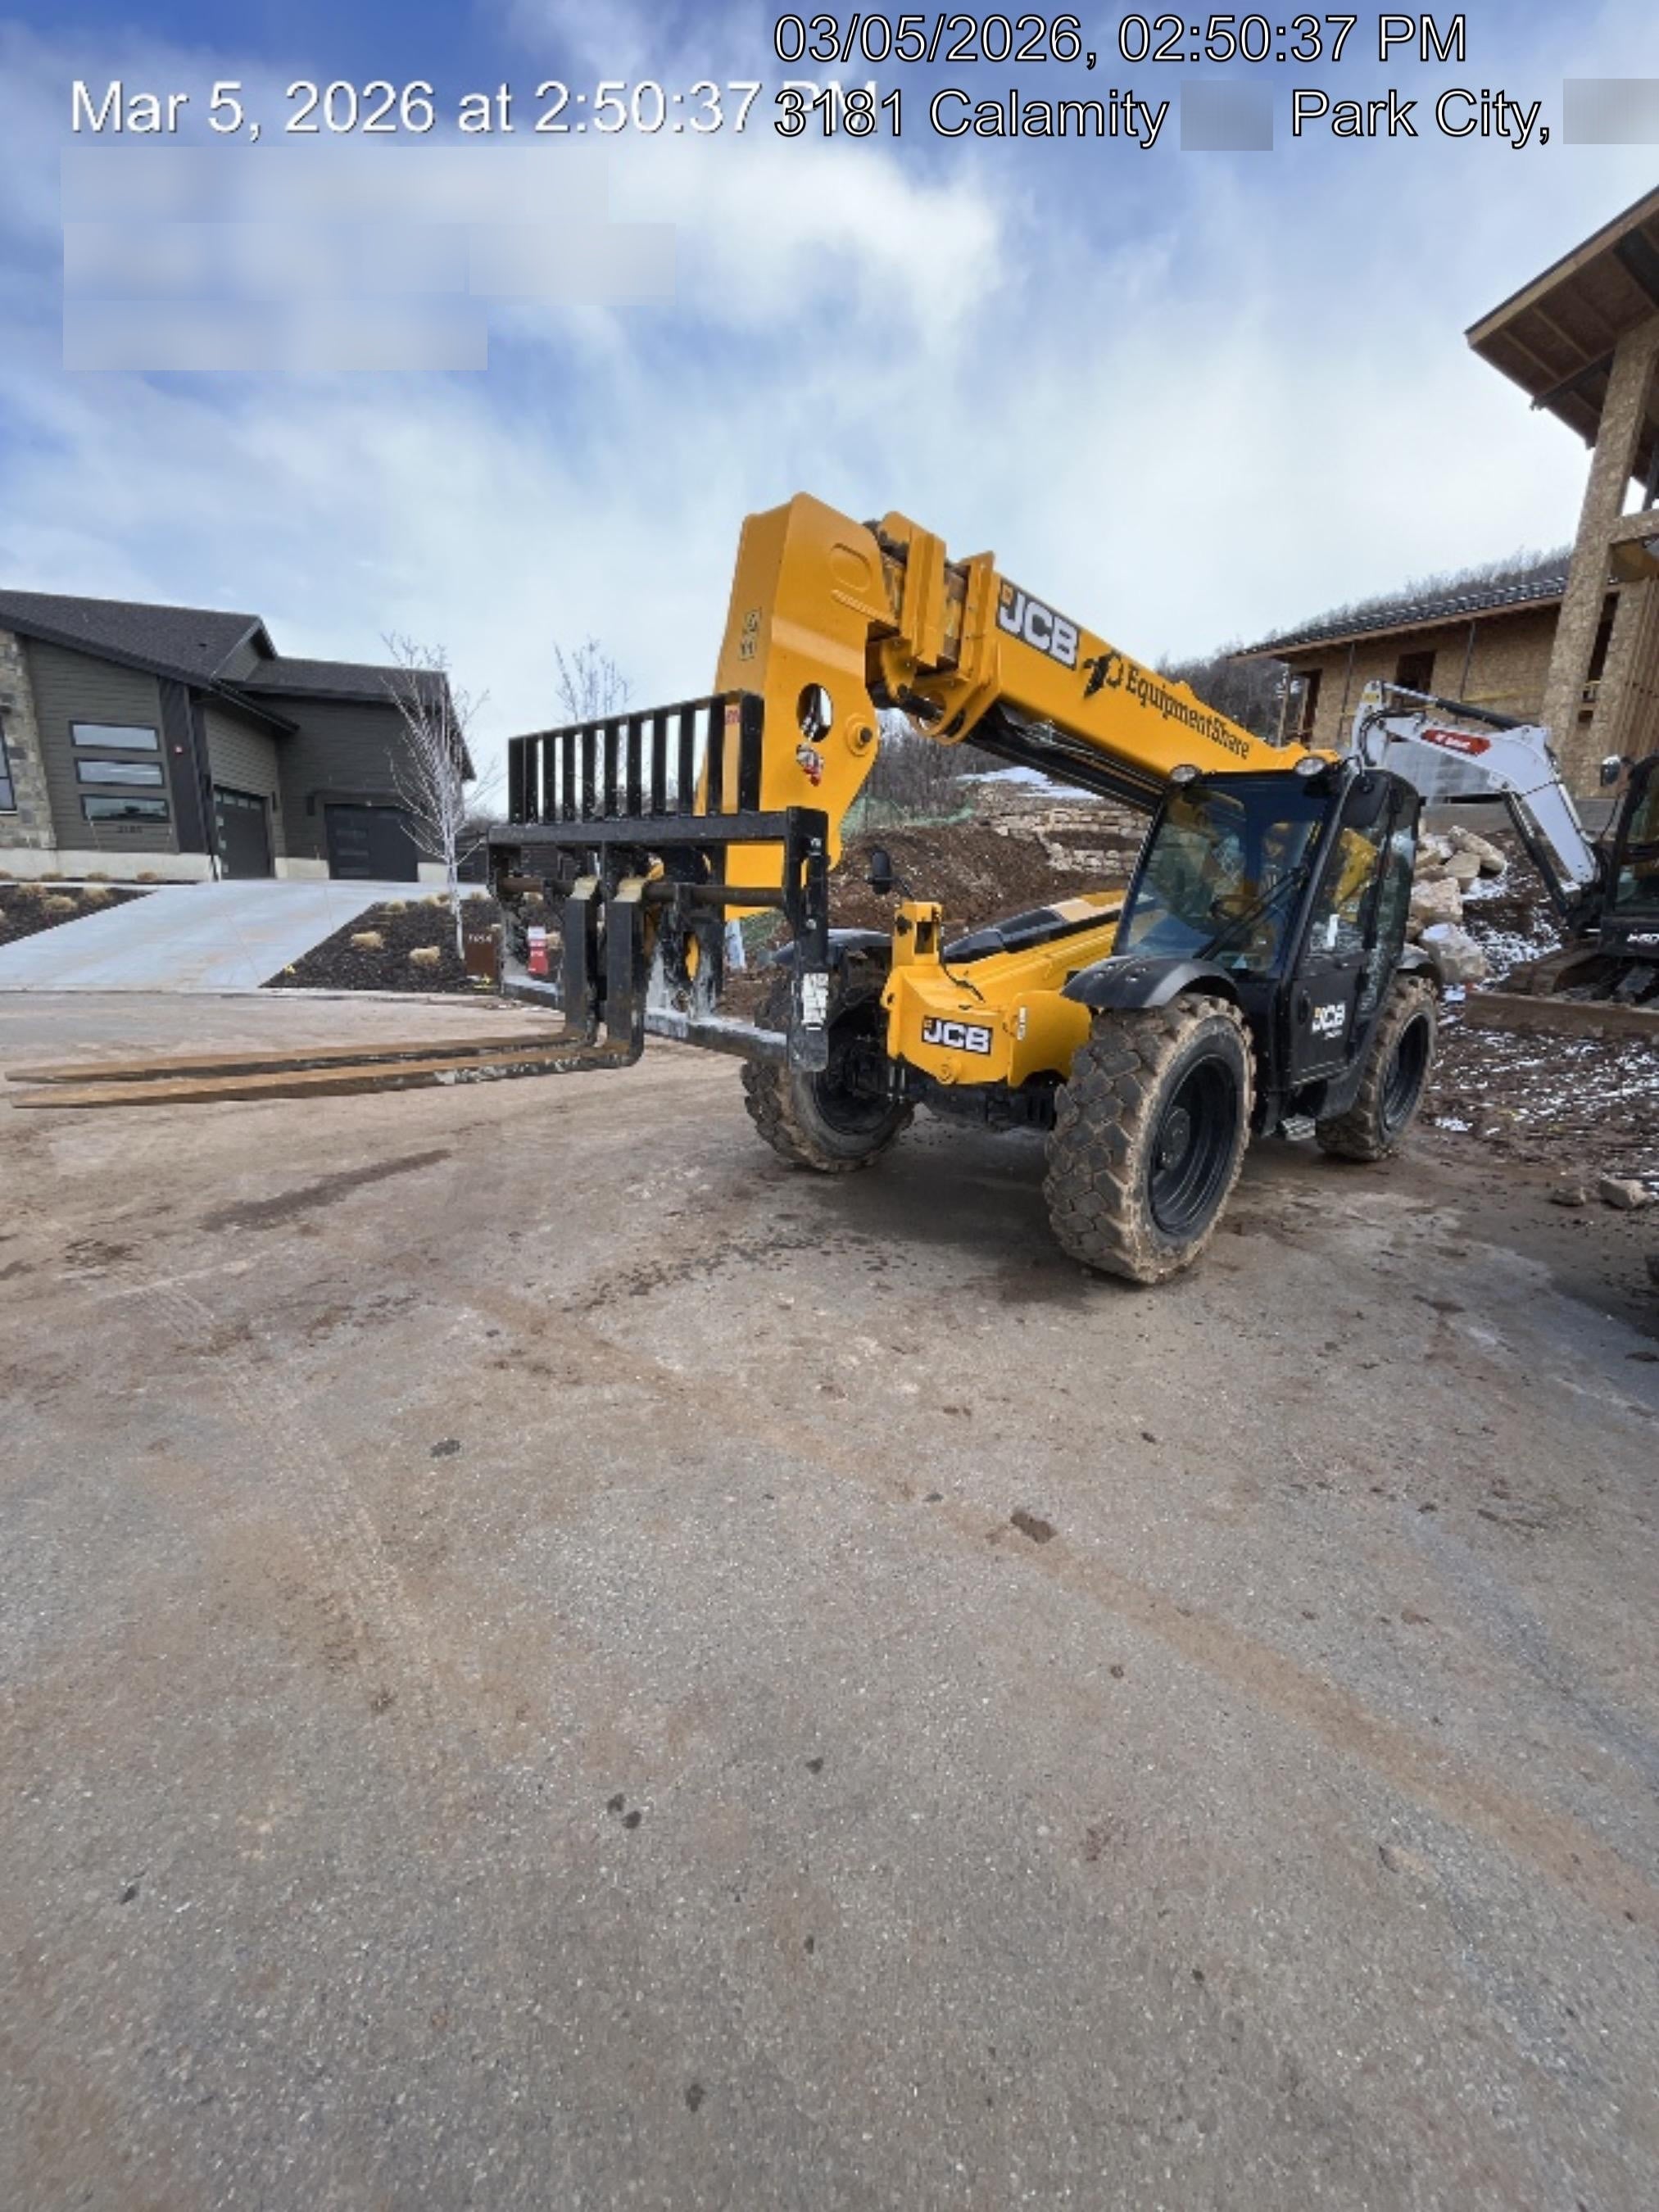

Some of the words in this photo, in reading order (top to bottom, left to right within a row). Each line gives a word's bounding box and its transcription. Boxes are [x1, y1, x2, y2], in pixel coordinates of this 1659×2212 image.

[999, 587, 1078, 667] JCB
[1126, 663, 1249, 760] EquipmentShare
[922, 1018, 990, 1054] JCB
